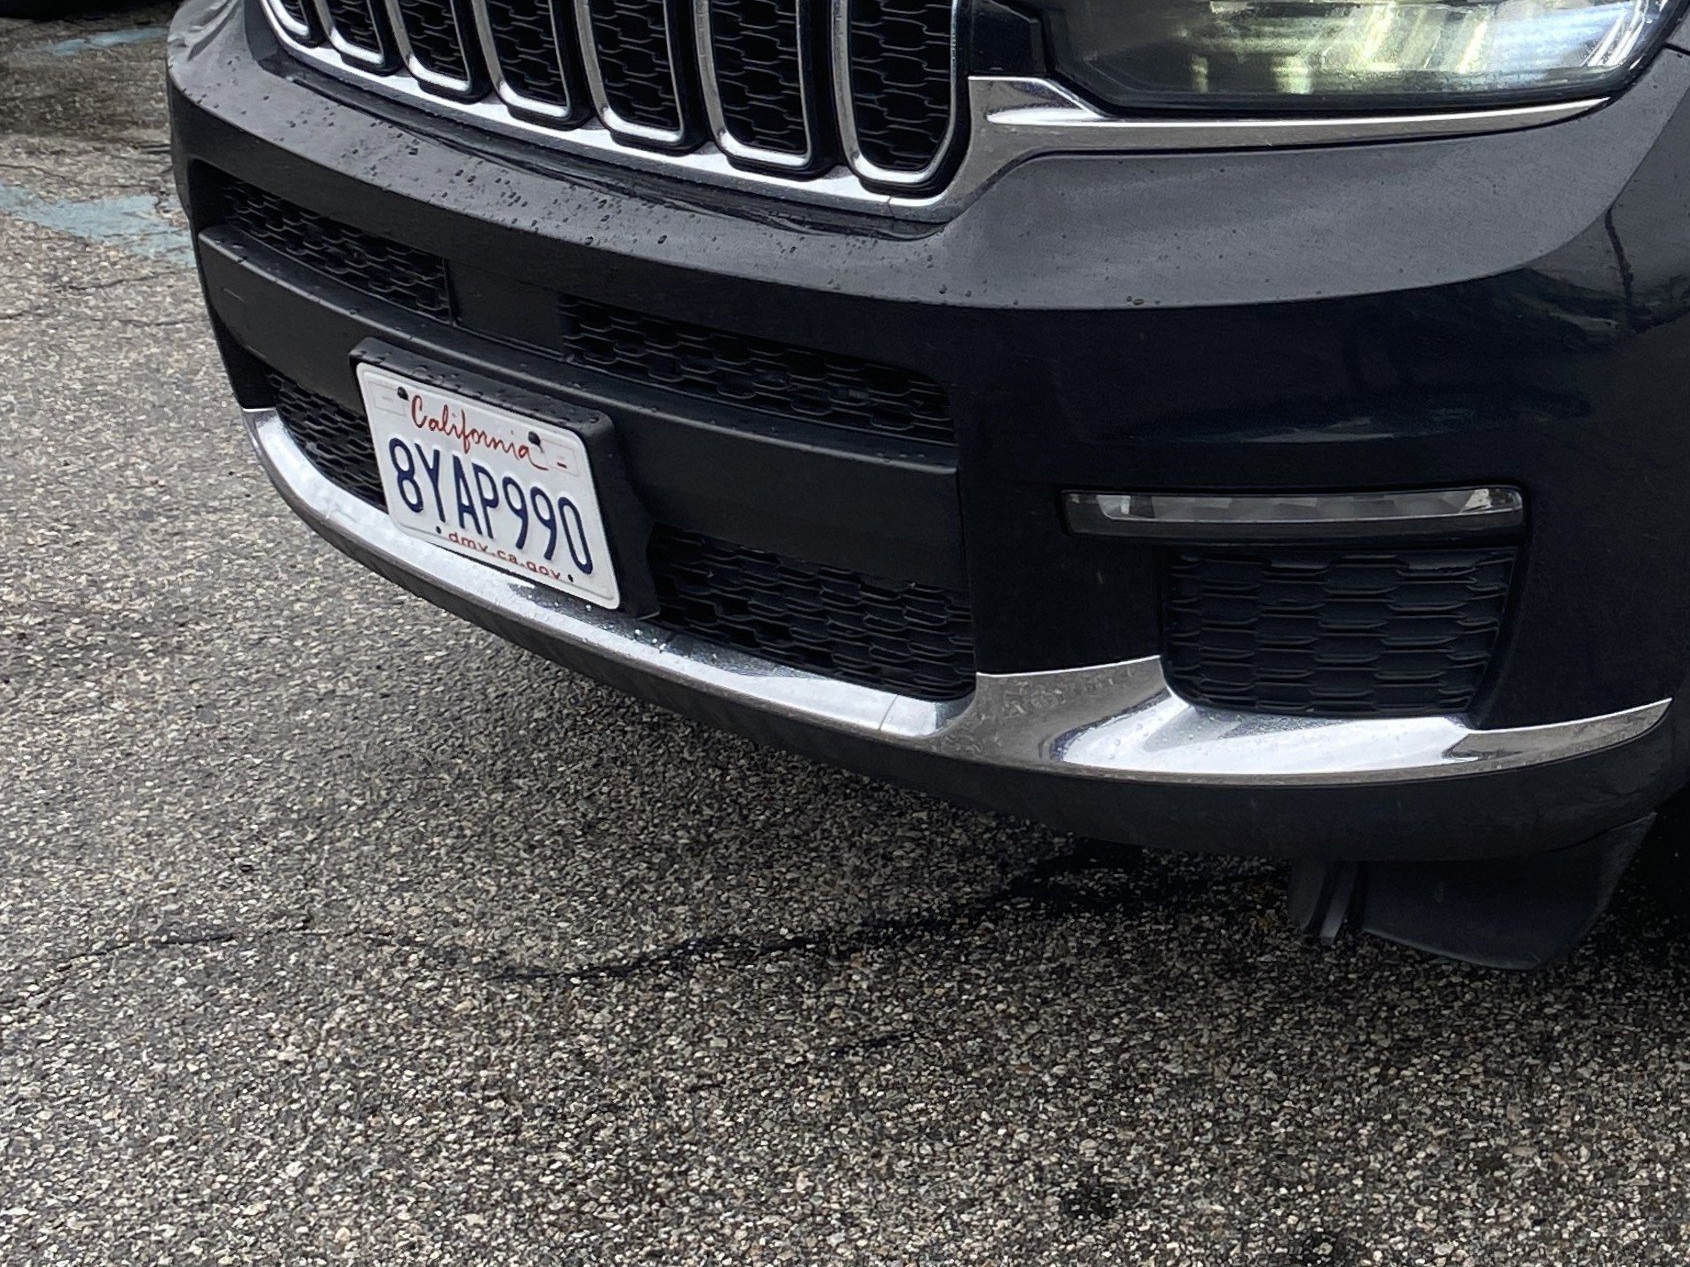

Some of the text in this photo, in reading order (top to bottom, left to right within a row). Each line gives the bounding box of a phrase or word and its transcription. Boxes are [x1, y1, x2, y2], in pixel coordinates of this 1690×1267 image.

[411, 394, 549, 470] California
[389, 437, 593, 575] 8YAP990
[448, 532, 562, 580] dmv.ca.gov
